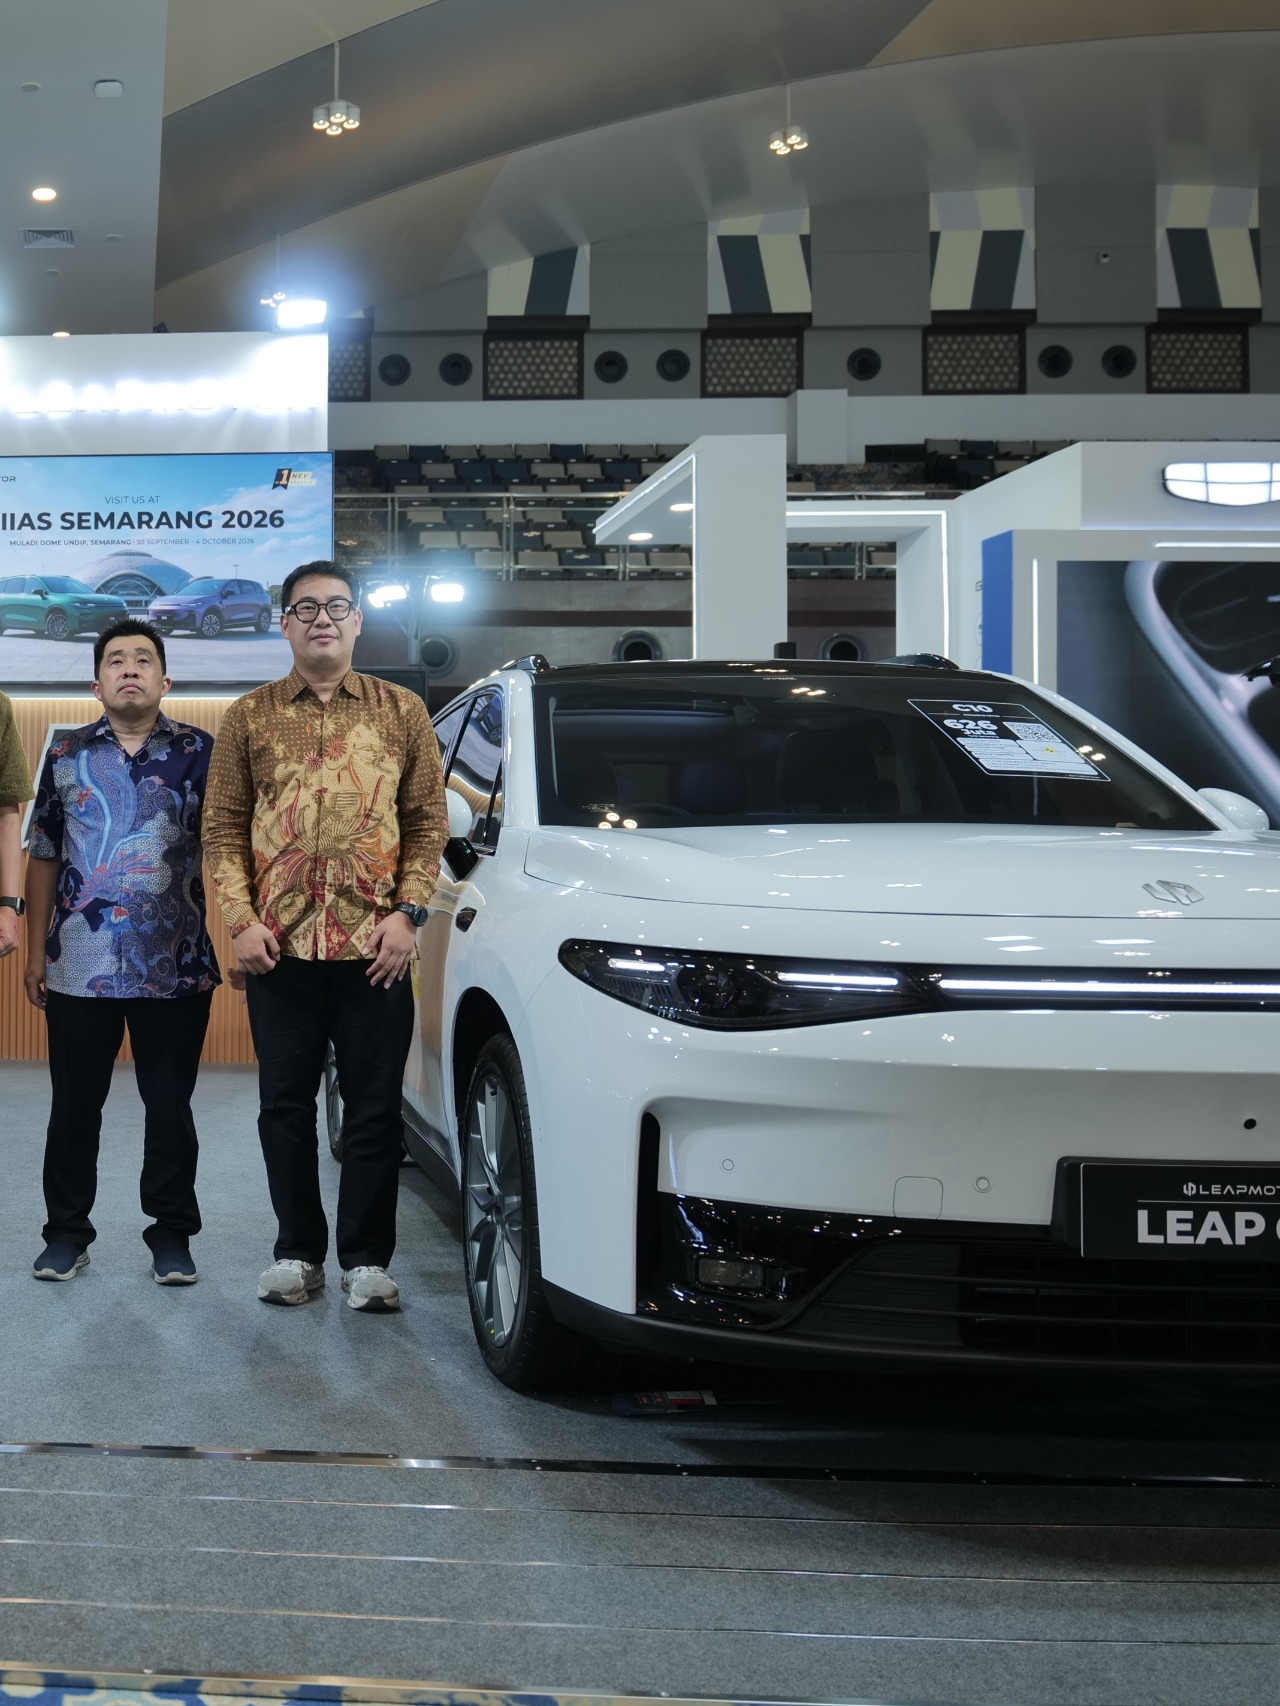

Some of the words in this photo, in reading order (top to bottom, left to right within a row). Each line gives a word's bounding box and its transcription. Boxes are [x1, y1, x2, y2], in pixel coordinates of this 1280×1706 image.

[104, 496, 130, 504] VISIT
[132, 496, 146, 504] US
[148, 495, 161, 504] AT
[60, 510, 213, 531] SEMARANG
[221, 509, 285, 529] 2026
[952, 704, 993, 713] C10
[943, 719, 998, 730] 626
[1137, 1209, 1266, 1245] LEAP
